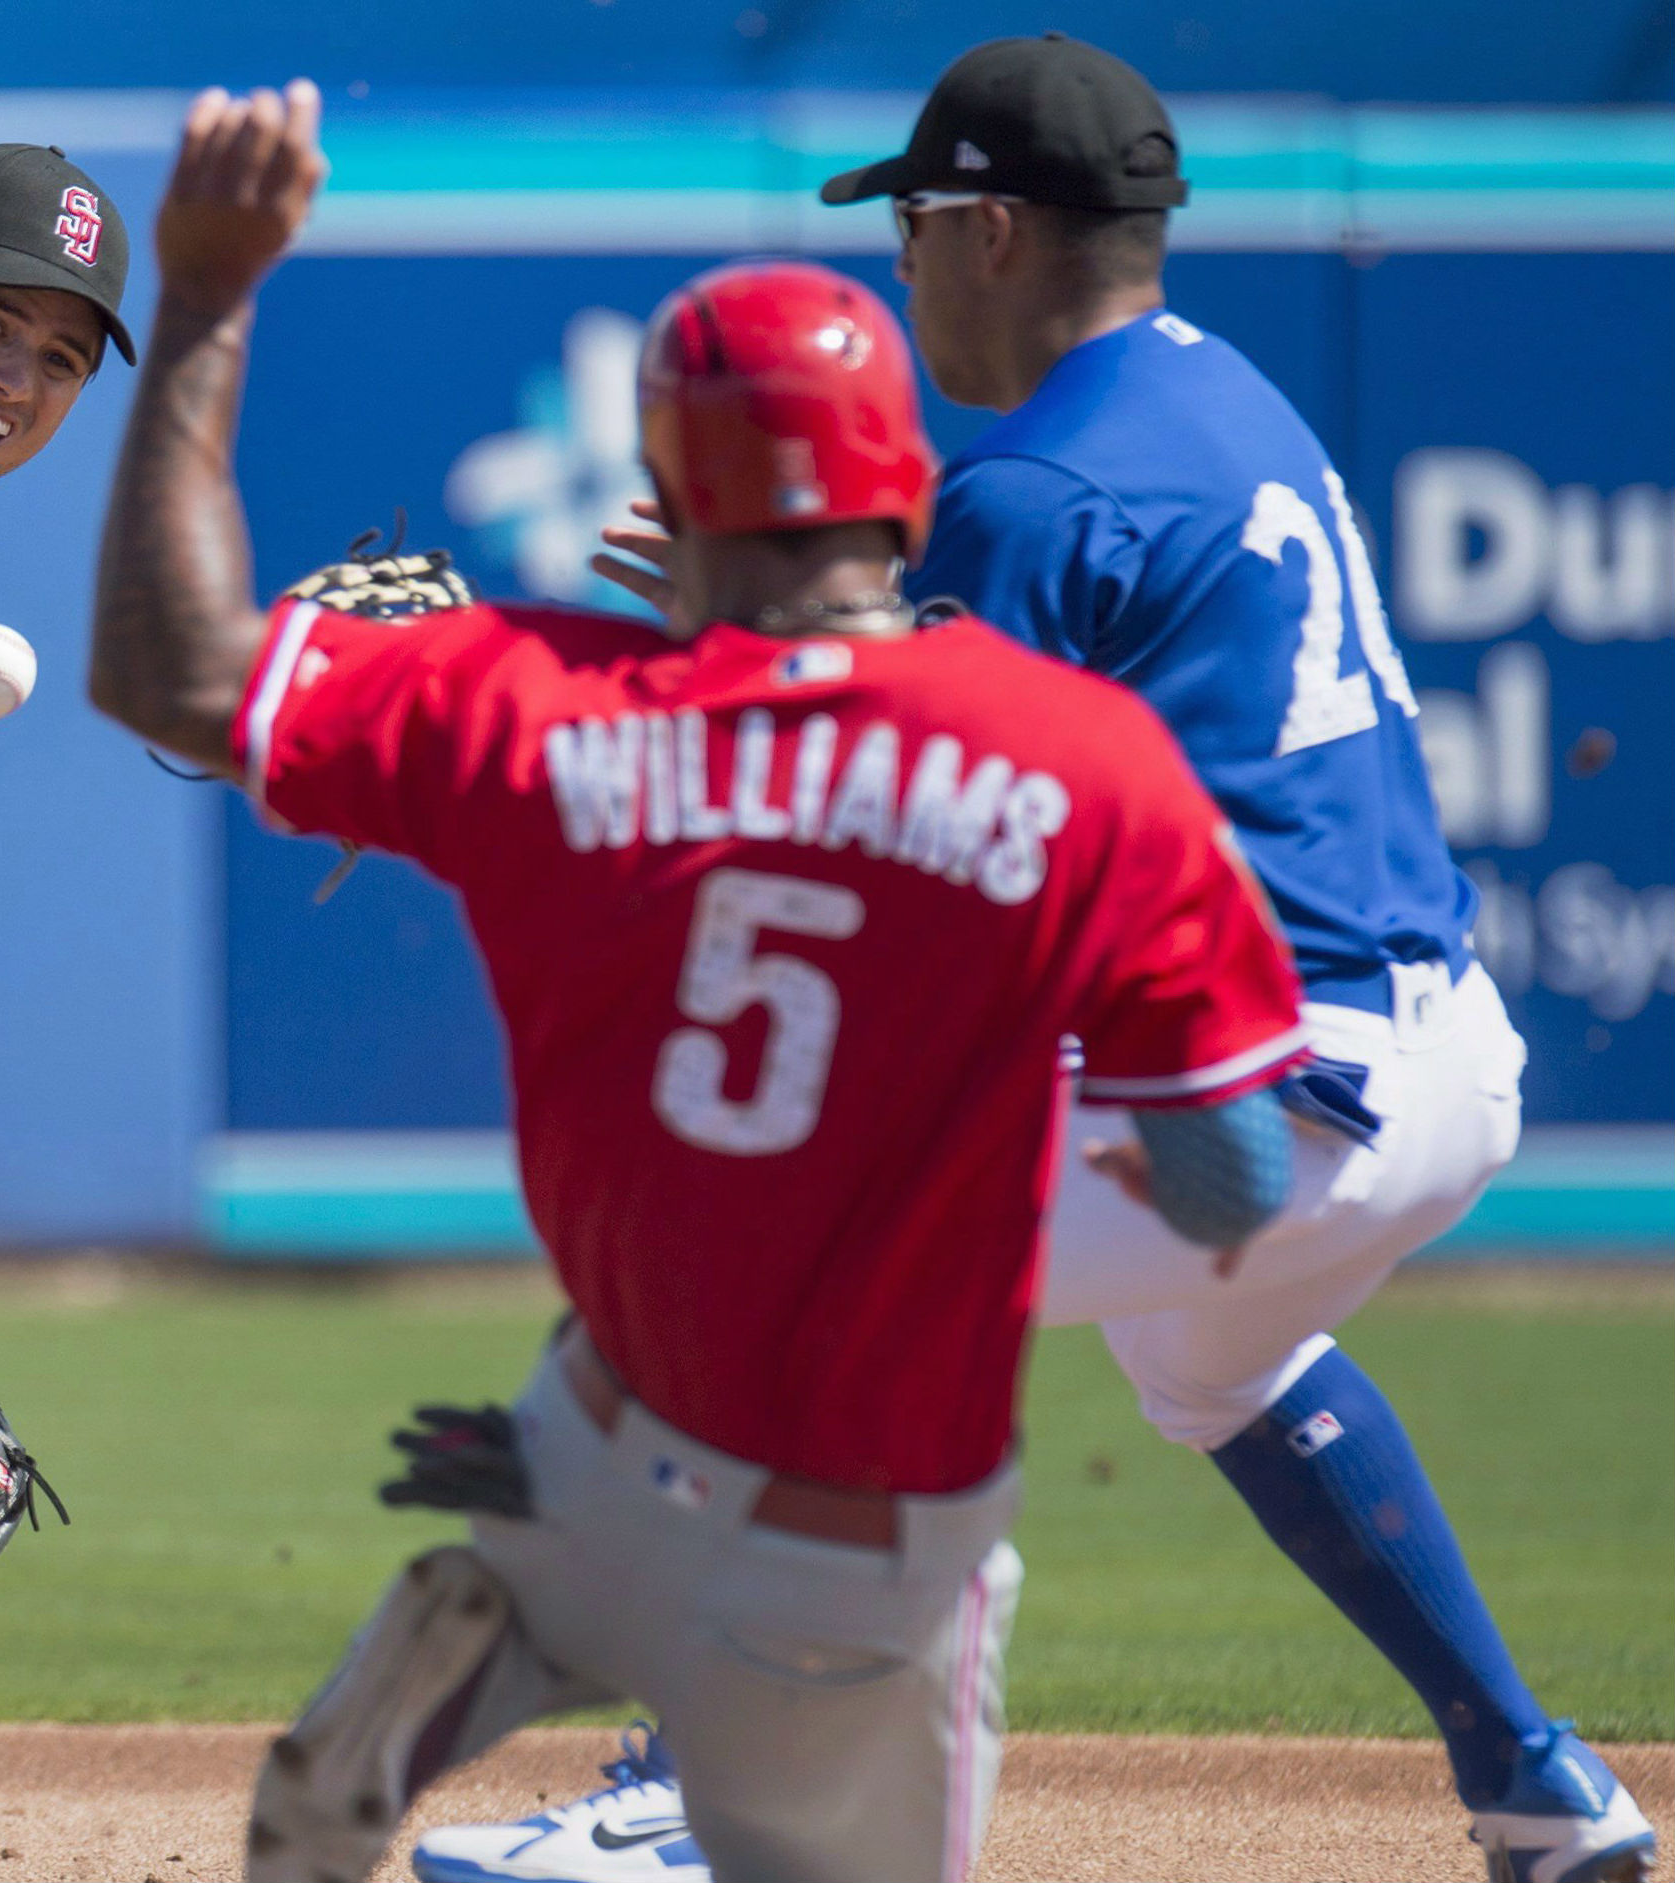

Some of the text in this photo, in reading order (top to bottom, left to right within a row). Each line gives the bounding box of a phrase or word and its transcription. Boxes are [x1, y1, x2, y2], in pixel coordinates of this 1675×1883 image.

[1391, 446, 1675, 642] Du
[545, 706, 1071, 906] WILLIAMS
[1418, 641, 1551, 848] al
[650, 867, 866, 1157] 5
